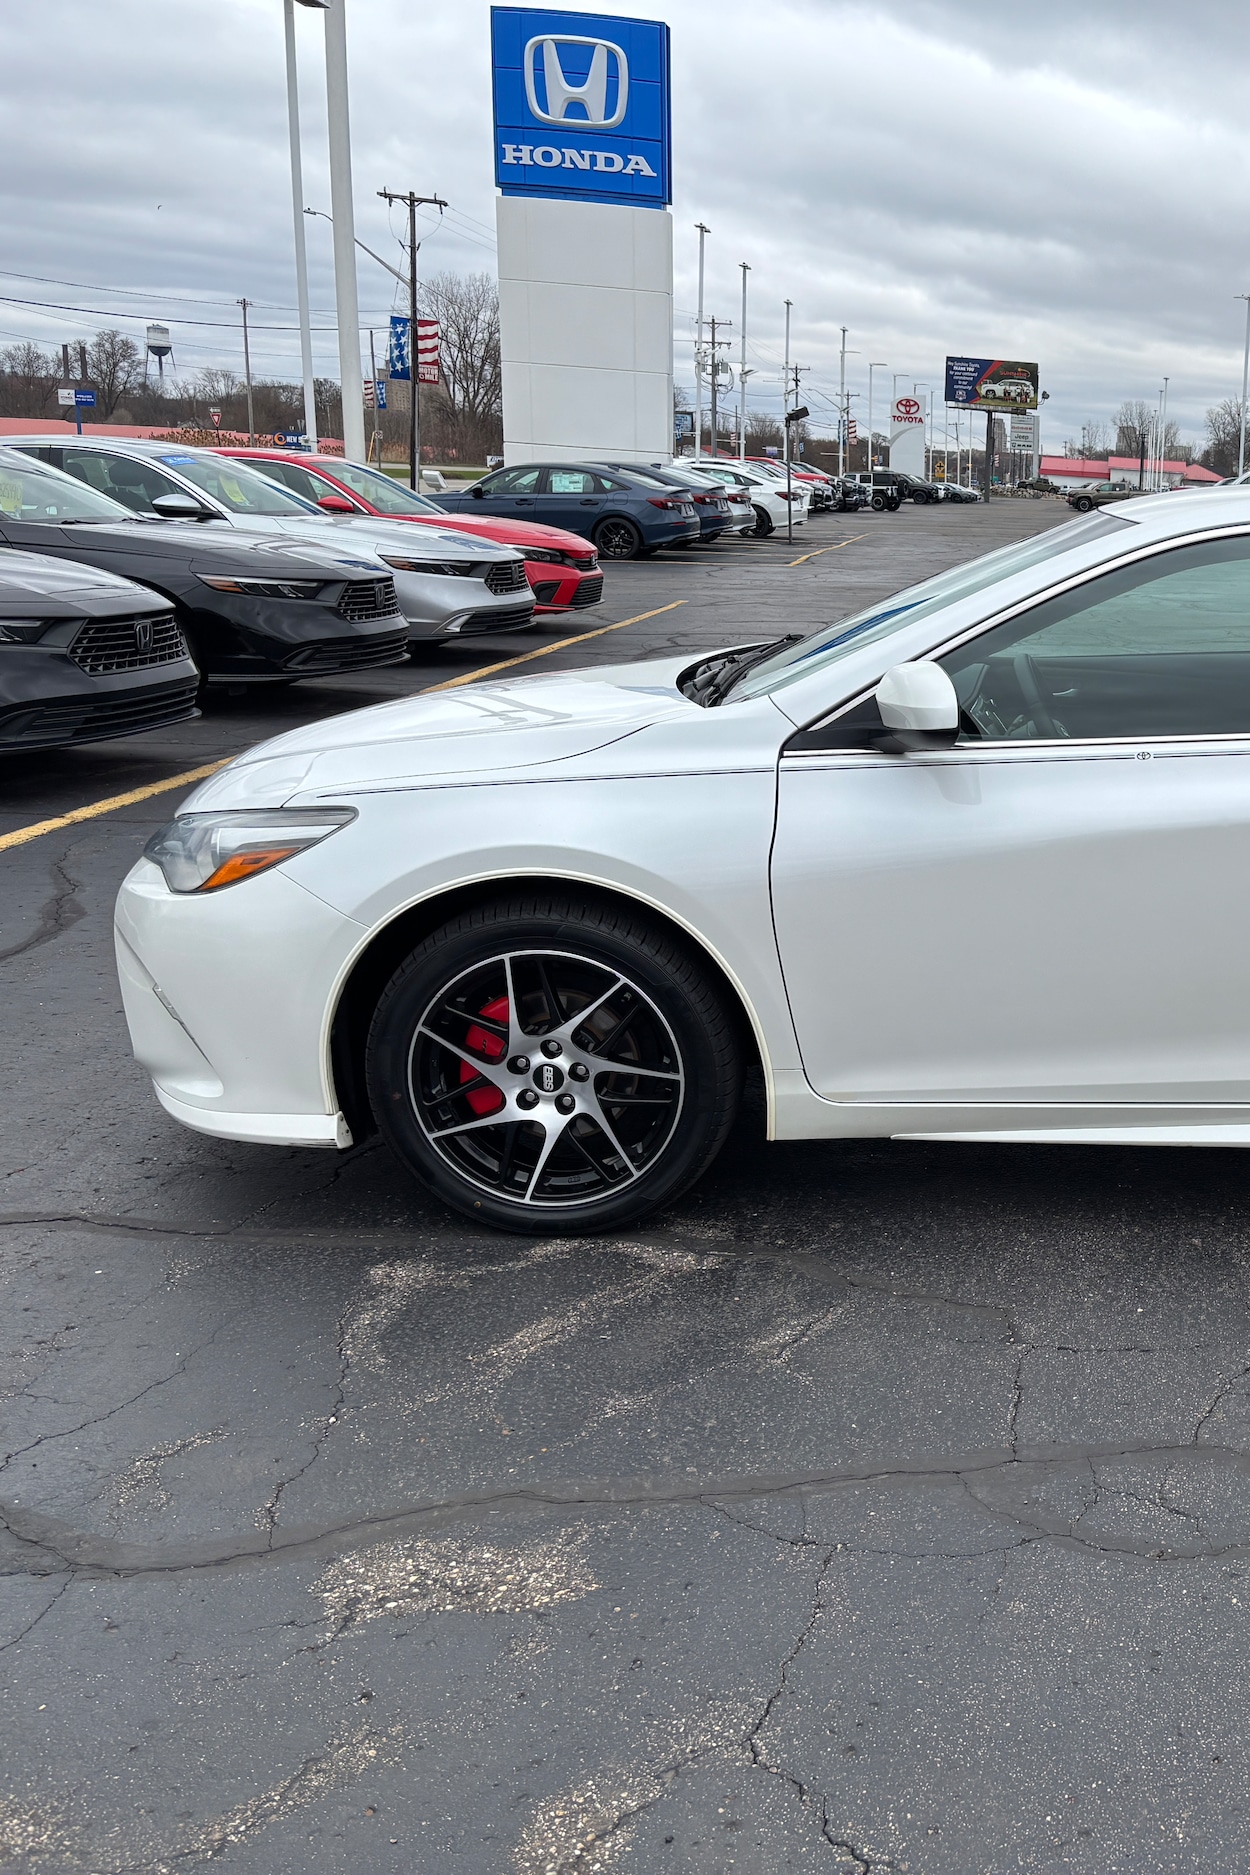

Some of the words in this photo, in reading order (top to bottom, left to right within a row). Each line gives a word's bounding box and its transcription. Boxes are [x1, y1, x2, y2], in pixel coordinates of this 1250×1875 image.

[502, 144, 657, 177] HONDA
[419, 367, 438, 375] MOTOR
[892, 415, 923, 424] TOYOTA
[1014, 433, 1030, 441] Jeep
[543, 1065, 554, 1091] BBS
